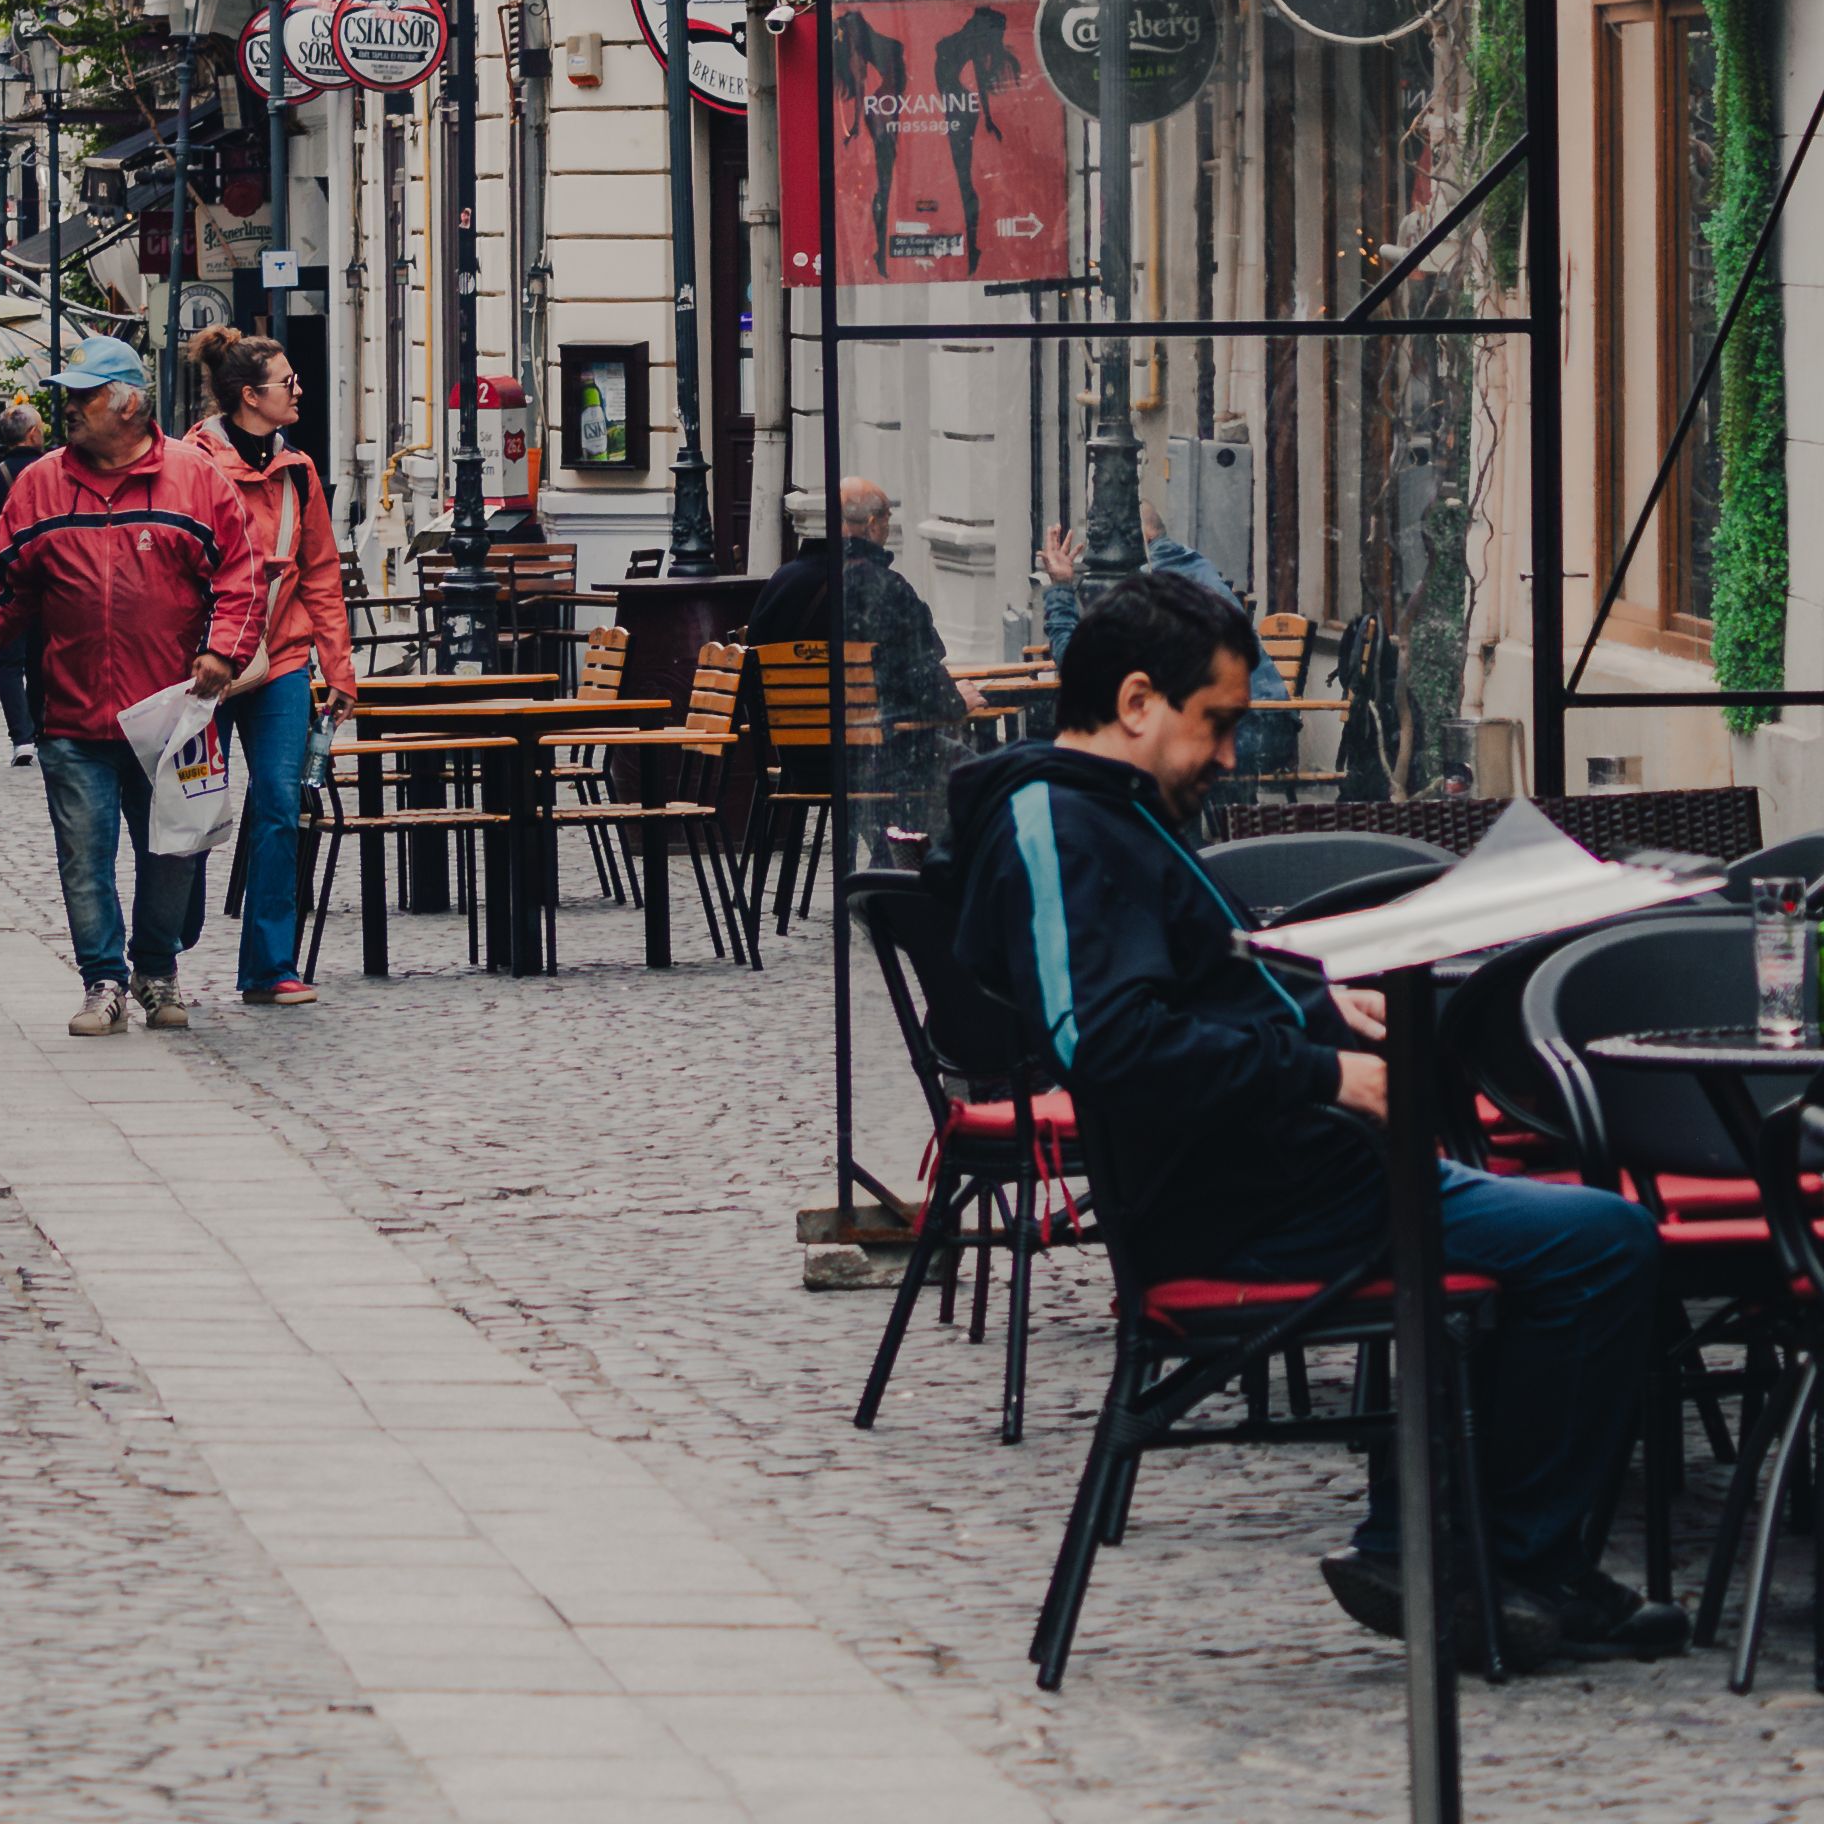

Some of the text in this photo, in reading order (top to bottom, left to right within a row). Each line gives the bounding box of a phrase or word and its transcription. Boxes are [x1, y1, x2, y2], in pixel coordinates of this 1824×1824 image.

[344, 14, 436, 48] CSIKI SÖR
[1061, 5, 1202, 54] Casberg
[692, 58, 747, 96] BREWER
[863, 92, 980, 116] ROXANNE
[885, 119, 961, 136] massage
